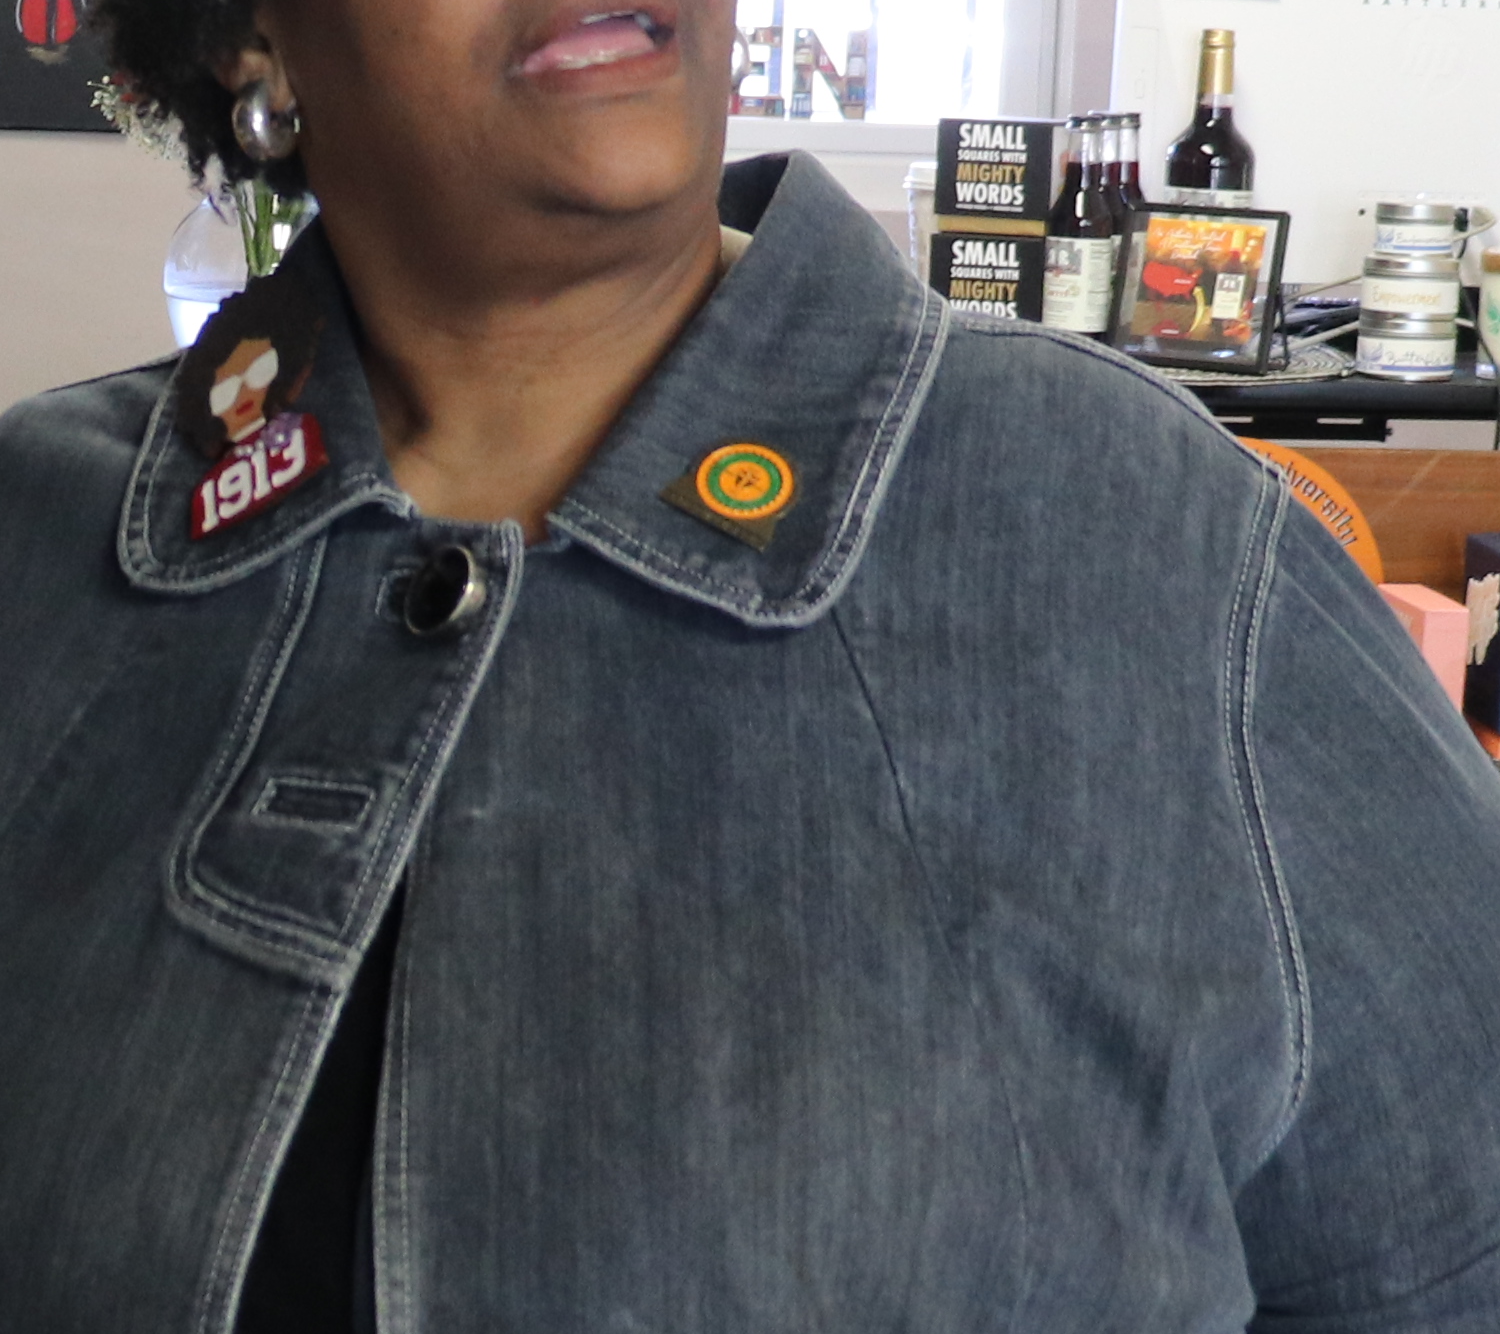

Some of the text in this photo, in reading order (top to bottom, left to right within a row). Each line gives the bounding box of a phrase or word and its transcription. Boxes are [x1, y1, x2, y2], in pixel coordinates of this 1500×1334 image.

[958, 122, 1027, 150] SMALL
[957, 149, 1028, 164] SQUARES WITH
[955, 162, 1026, 184] MIGHTY
[955, 181, 1025, 206] WORDS
[951, 239, 1020, 268] SMALL
[950, 266, 1020, 281] SQUARES WITH
[949, 278, 1019, 301] MIGHTY
[199, 424, 308, 534] 1913
